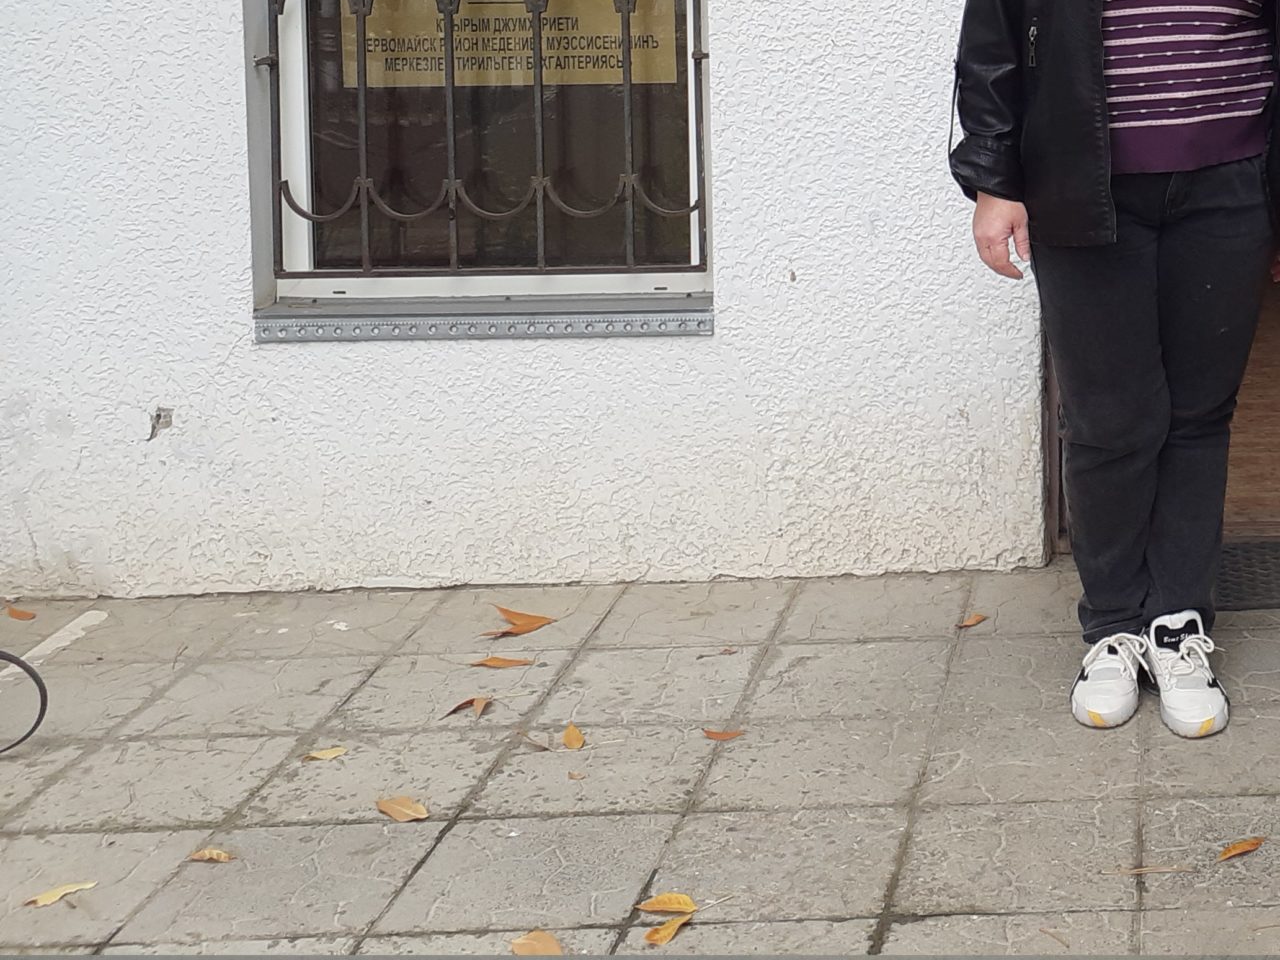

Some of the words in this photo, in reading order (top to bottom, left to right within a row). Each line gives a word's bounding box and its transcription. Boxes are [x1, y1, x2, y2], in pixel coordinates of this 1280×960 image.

[436, 17, 490, 33] КЫРЫМ
[494, 17, 579, 34] ДЖУМХРИЕТИ
[366, 35, 437, 52] ЕРВОМАЙСК
[385, 56, 522, 72] МЕРКЕЗЛЕТИРИЛЬГЕН
